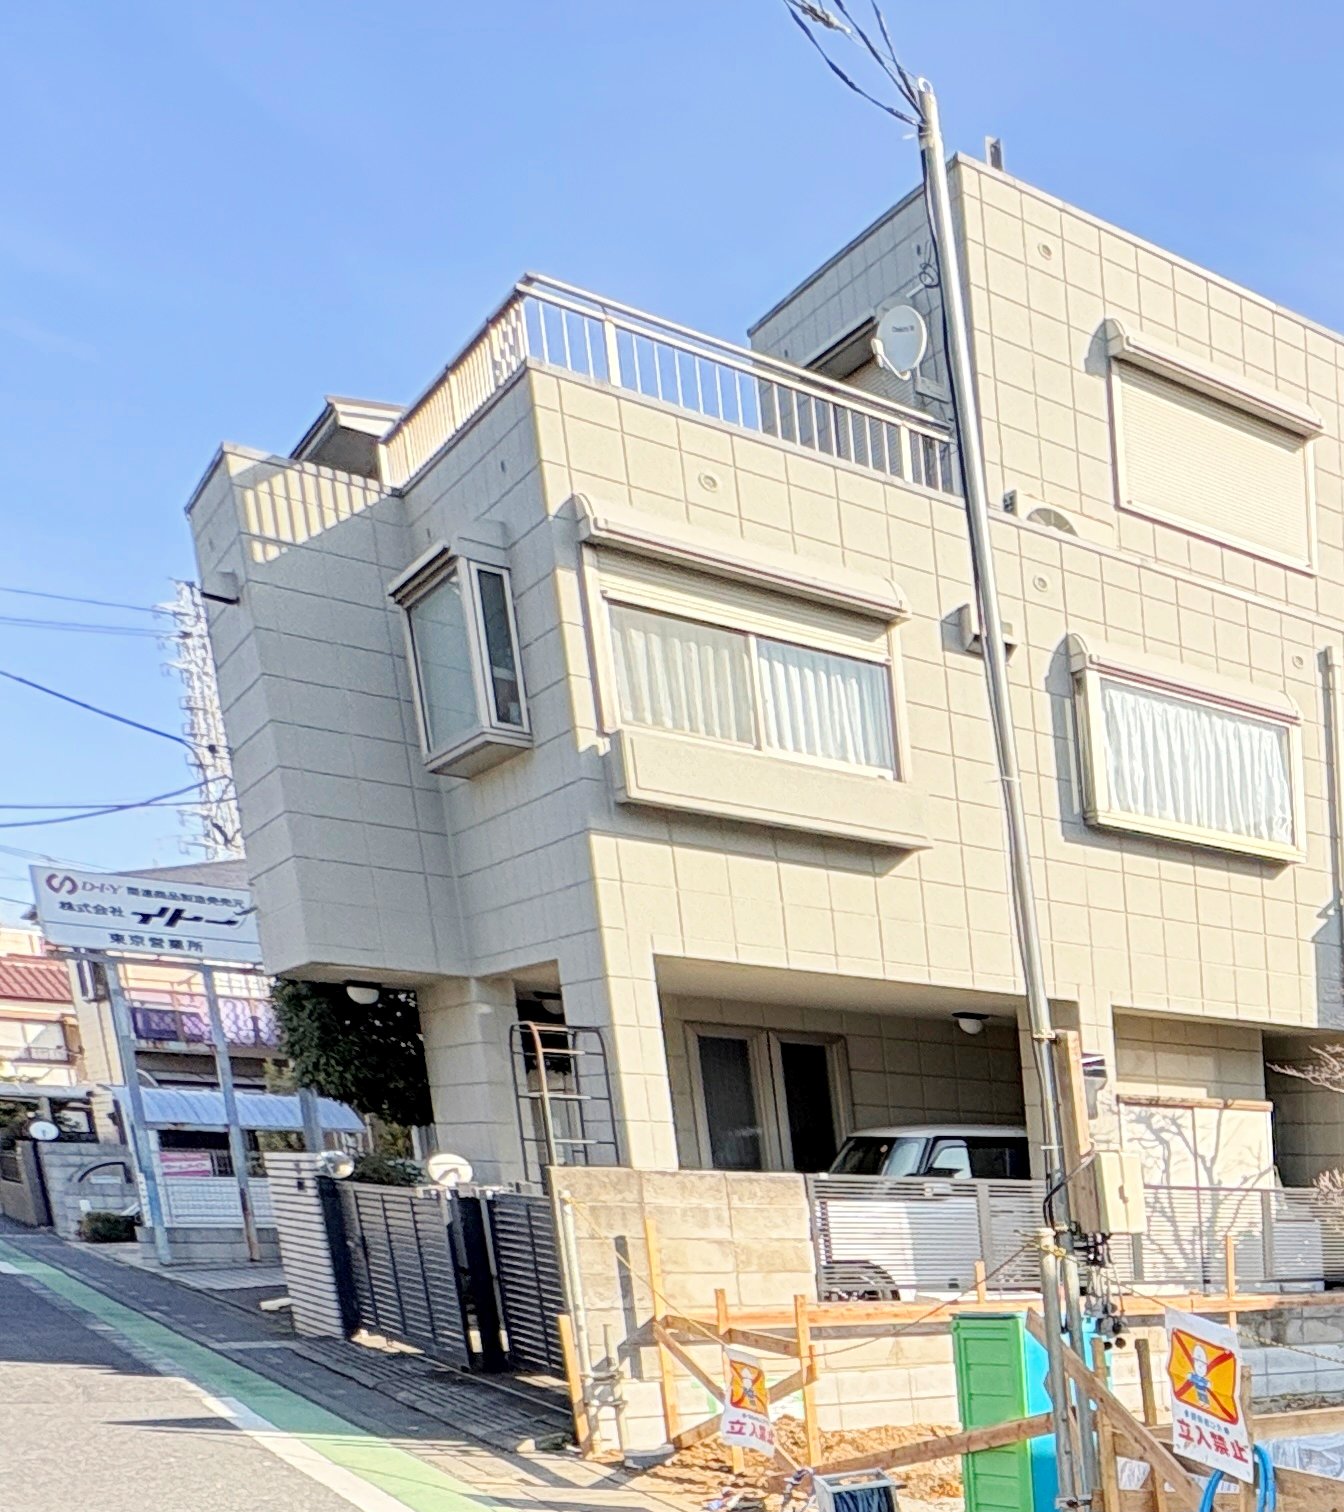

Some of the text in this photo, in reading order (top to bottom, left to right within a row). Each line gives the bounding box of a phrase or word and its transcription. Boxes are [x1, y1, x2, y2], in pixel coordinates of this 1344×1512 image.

[59, 900, 239, 927] 株式会社 イトー
[109, 933, 203, 953] 東京営業所
[1177, 1418, 1249, 1464] 立入禁止
